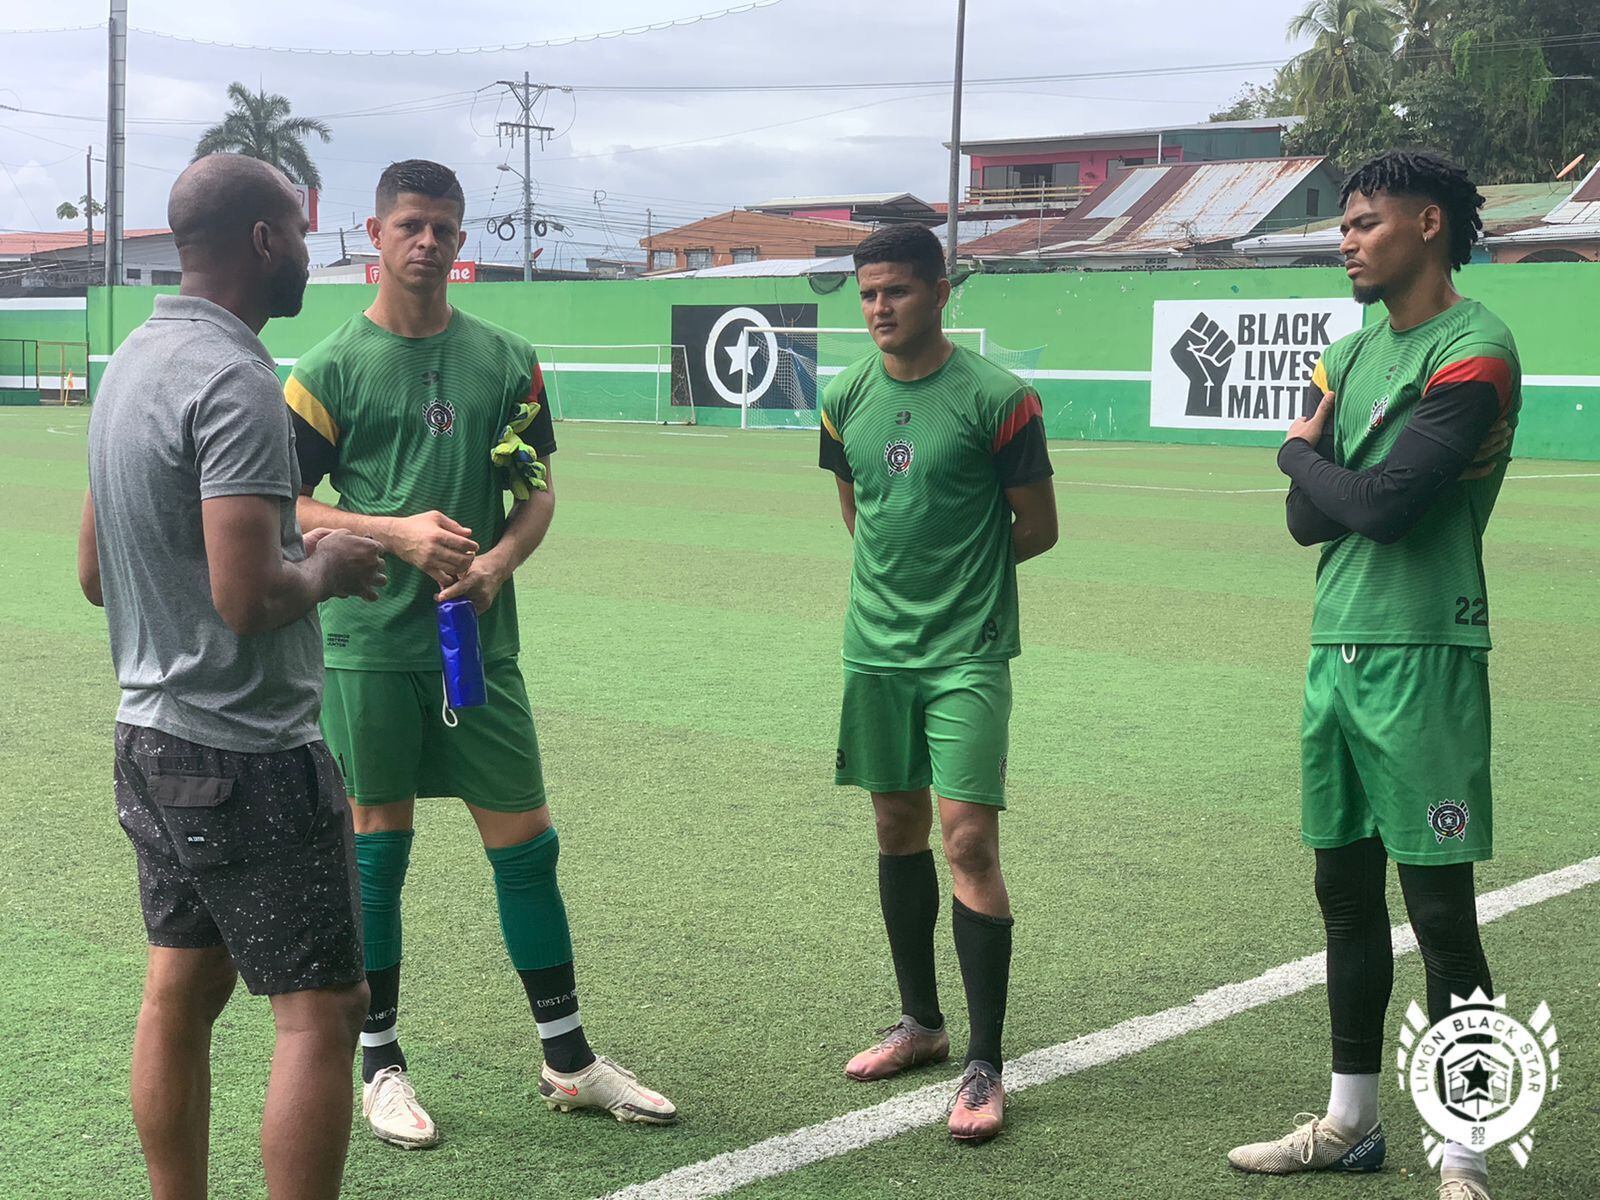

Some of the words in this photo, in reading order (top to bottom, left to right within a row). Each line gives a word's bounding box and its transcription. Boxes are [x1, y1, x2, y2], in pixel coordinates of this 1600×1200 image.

[1237, 313, 1332, 346] BLACK
[1244, 350, 1321, 381] LIVES
[1455, 596, 1489, 626] 22
